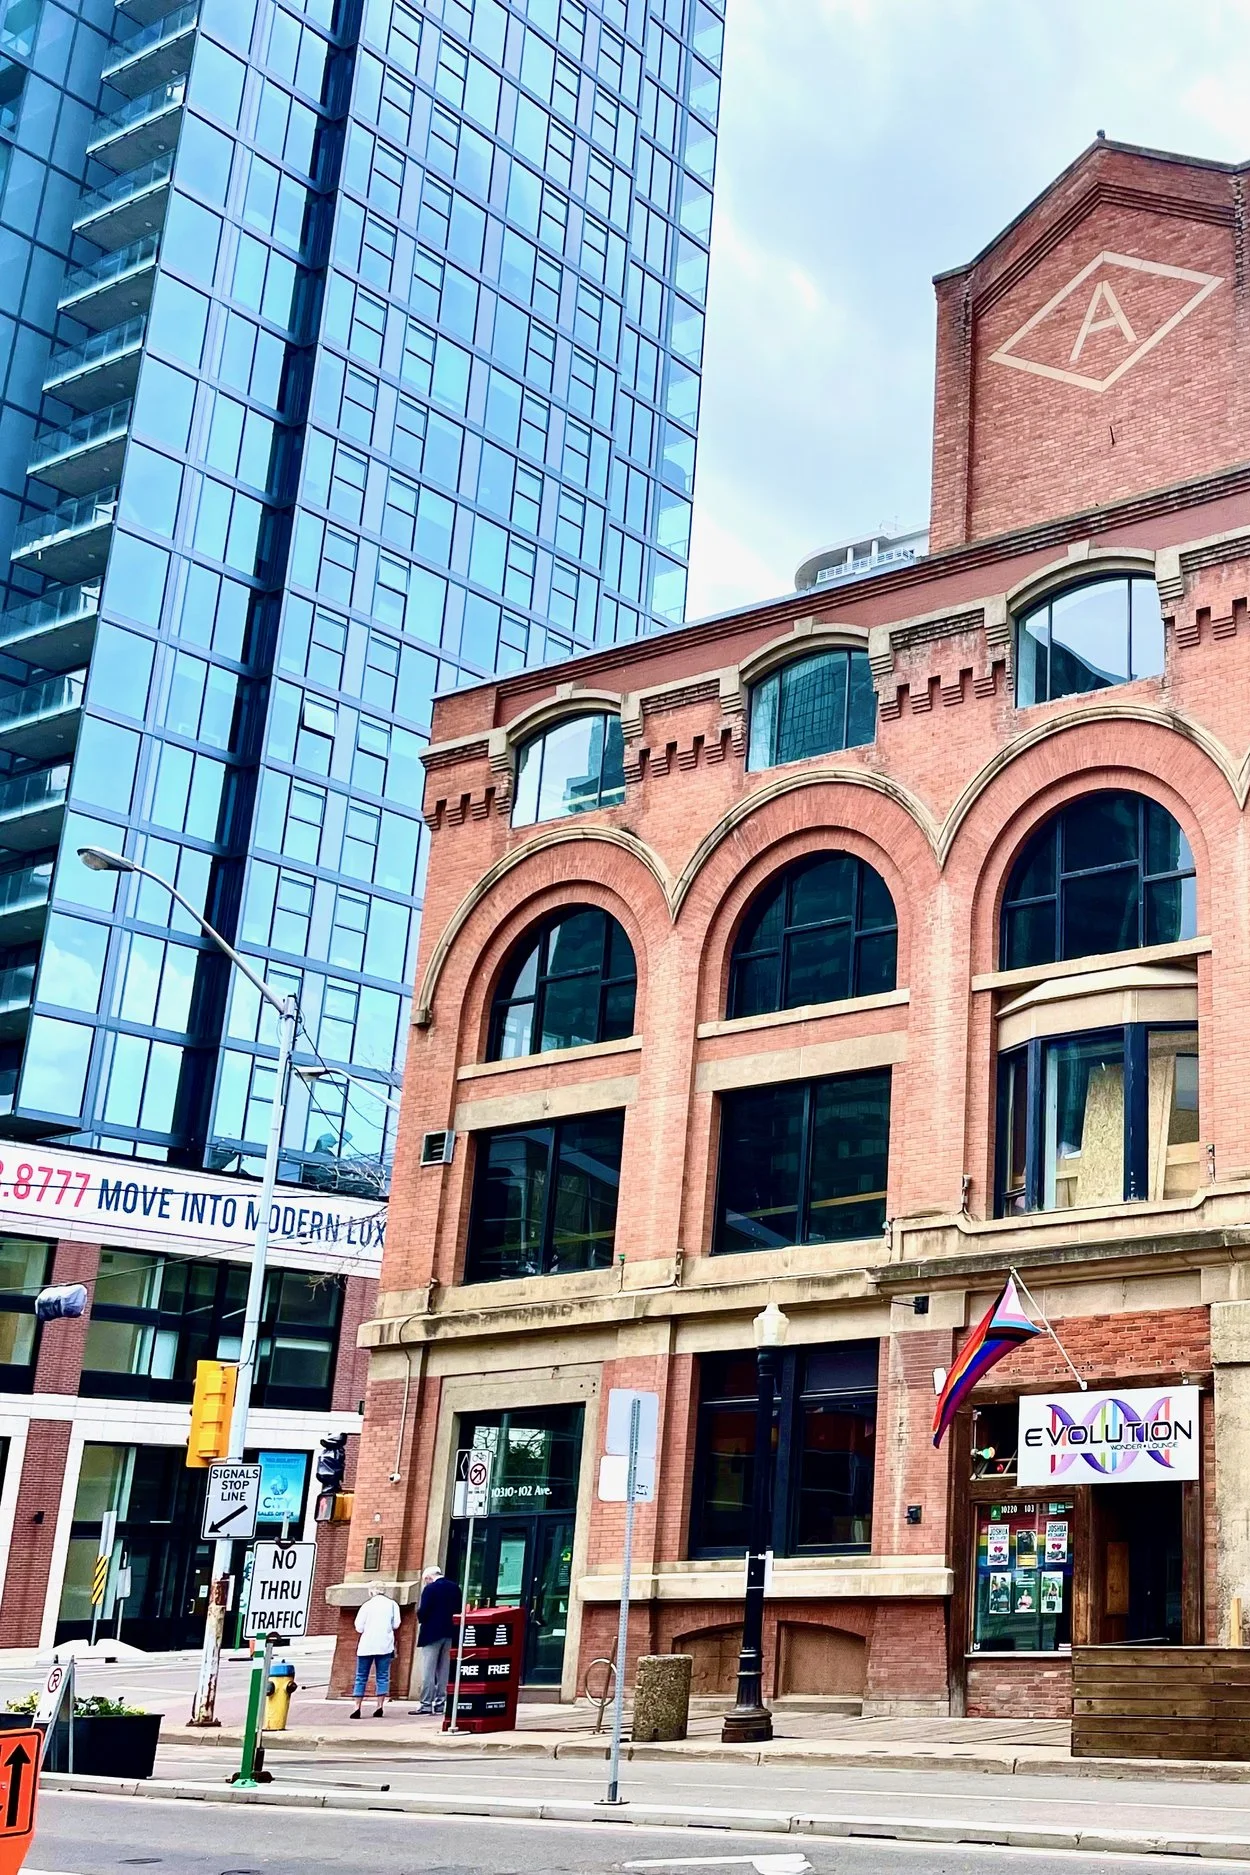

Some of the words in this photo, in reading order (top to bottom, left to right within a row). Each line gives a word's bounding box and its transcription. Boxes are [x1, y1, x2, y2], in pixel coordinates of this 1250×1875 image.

[97, 1178, 173, 1219] MOVE
[181, 1191, 237, 1228] INTO
[244, 1200, 341, 1243] MODERN
[1025, 1420, 1192, 1447] EVOLUTION
[212, 1469, 259, 1479] SIGNALS
[221, 1480, 250, 1490] STOP
[221, 1492, 246, 1501] LINE
[272, 1550, 297, 1569] NO
[260, 1580, 302, 1600] THRU
[251, 1610, 304, 1630] TRAFFIC
[488, 1664, 510, 1675] FREE
